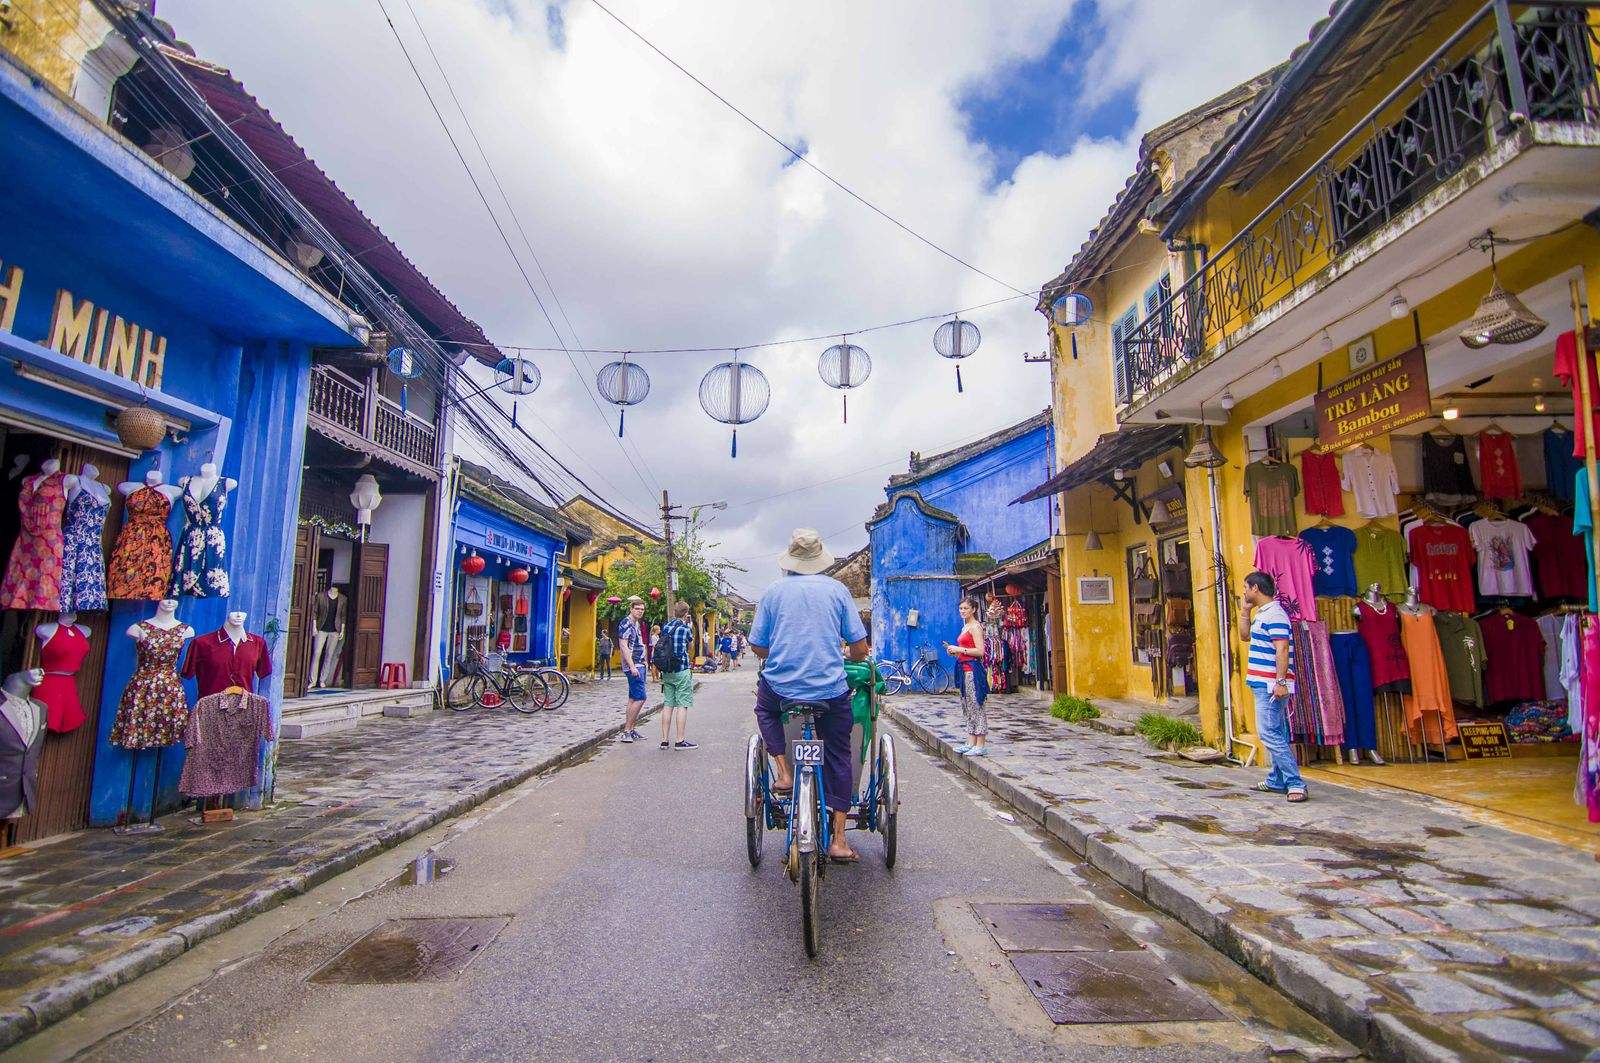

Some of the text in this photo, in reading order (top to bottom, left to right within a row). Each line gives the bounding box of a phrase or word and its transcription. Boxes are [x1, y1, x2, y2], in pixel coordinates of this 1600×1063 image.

[49, 287, 167, 391] MINH
[1325, 373, 1409, 421] TRE LÀNG
[1337, 403, 1399, 435] Bambou
[795, 744, 821, 761] 022
